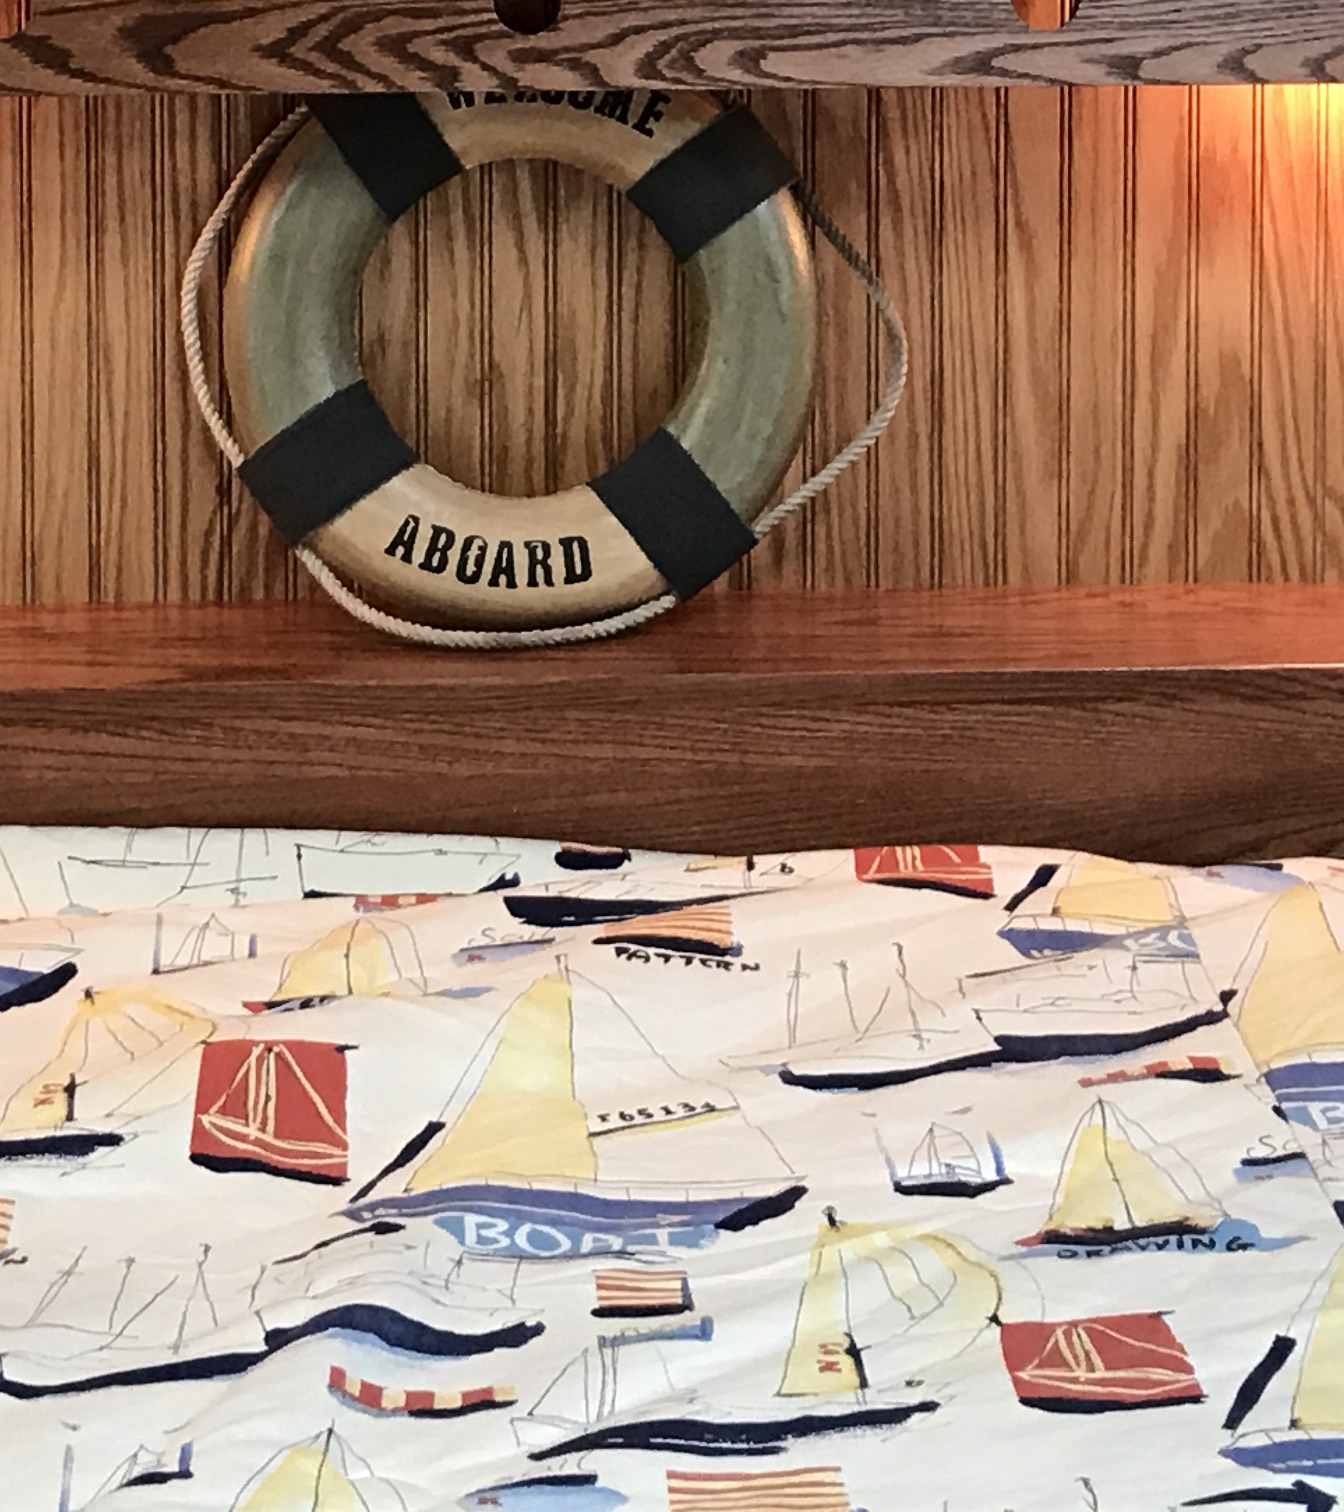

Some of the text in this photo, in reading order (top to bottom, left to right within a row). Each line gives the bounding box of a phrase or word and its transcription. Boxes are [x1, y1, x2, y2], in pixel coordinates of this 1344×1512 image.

[384, 514, 593, 589] ABOARD
[614, 946, 761, 973] PATTERN
[462, 1214, 678, 1256] BOAT
[1056, 1235, 1256, 1260] DRAWING
